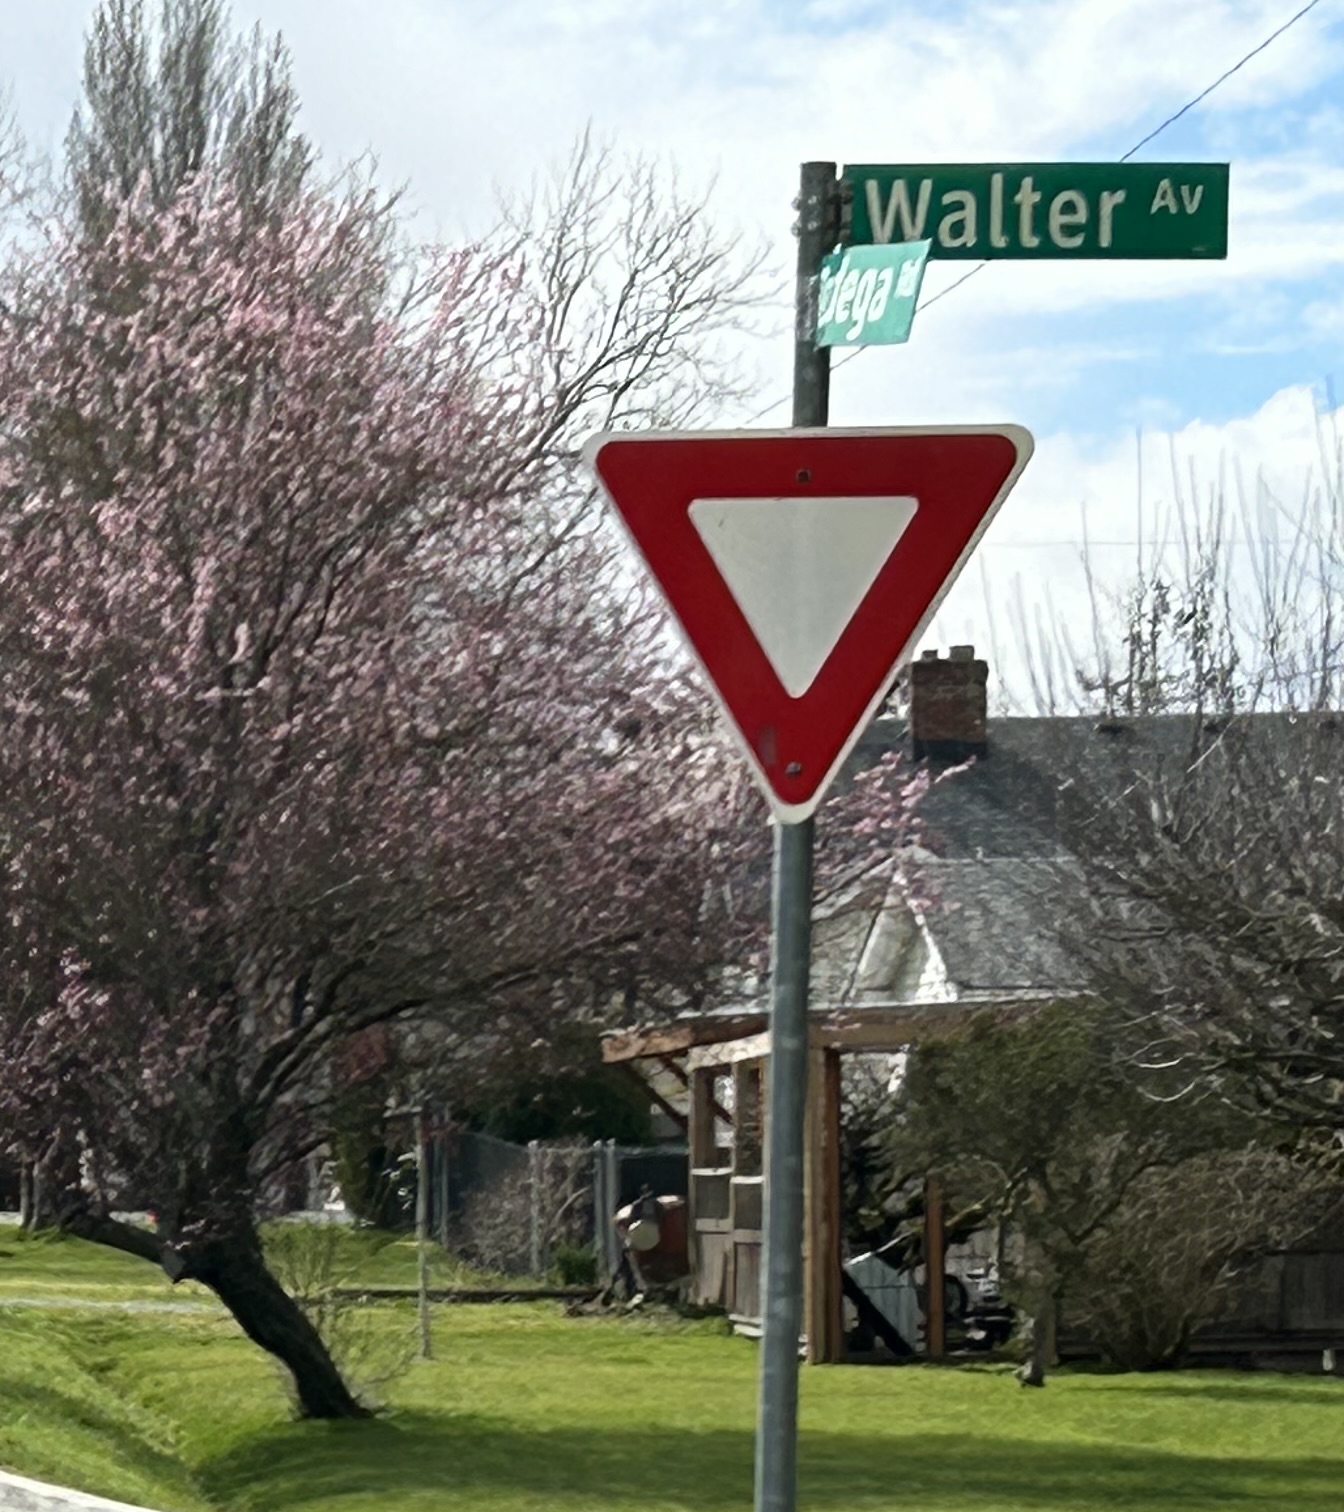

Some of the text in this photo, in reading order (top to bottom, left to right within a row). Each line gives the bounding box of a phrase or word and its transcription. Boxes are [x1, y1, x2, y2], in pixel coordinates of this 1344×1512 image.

[864, 172, 1205, 250] Walter Av
[817, 253, 894, 341] dega
